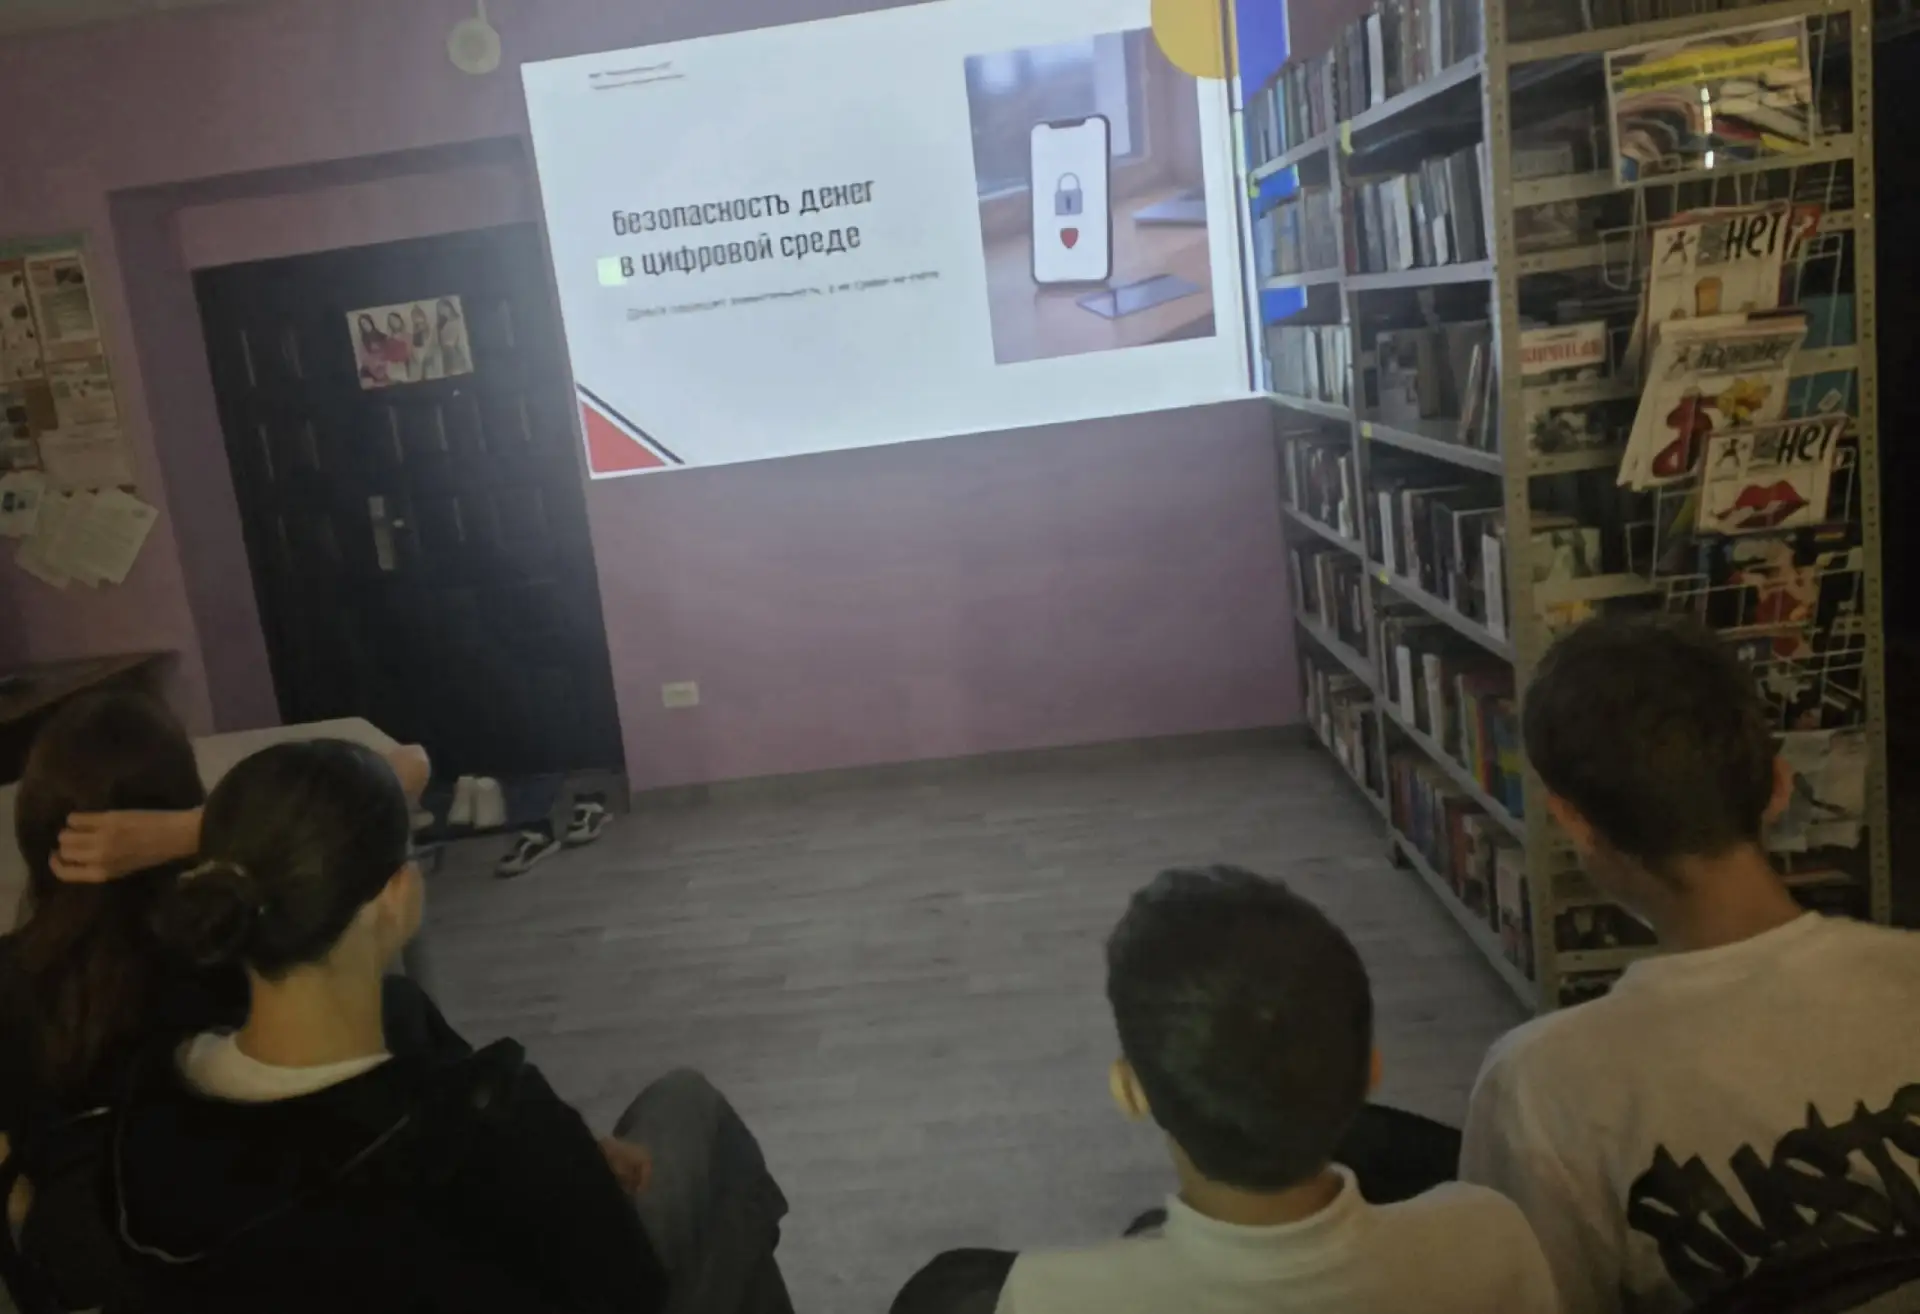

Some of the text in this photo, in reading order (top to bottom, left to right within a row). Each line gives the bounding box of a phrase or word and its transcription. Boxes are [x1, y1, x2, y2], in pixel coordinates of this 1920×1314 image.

[798, 180, 875, 216] денег
[619, 225, 862, 277] в цифровой среде
